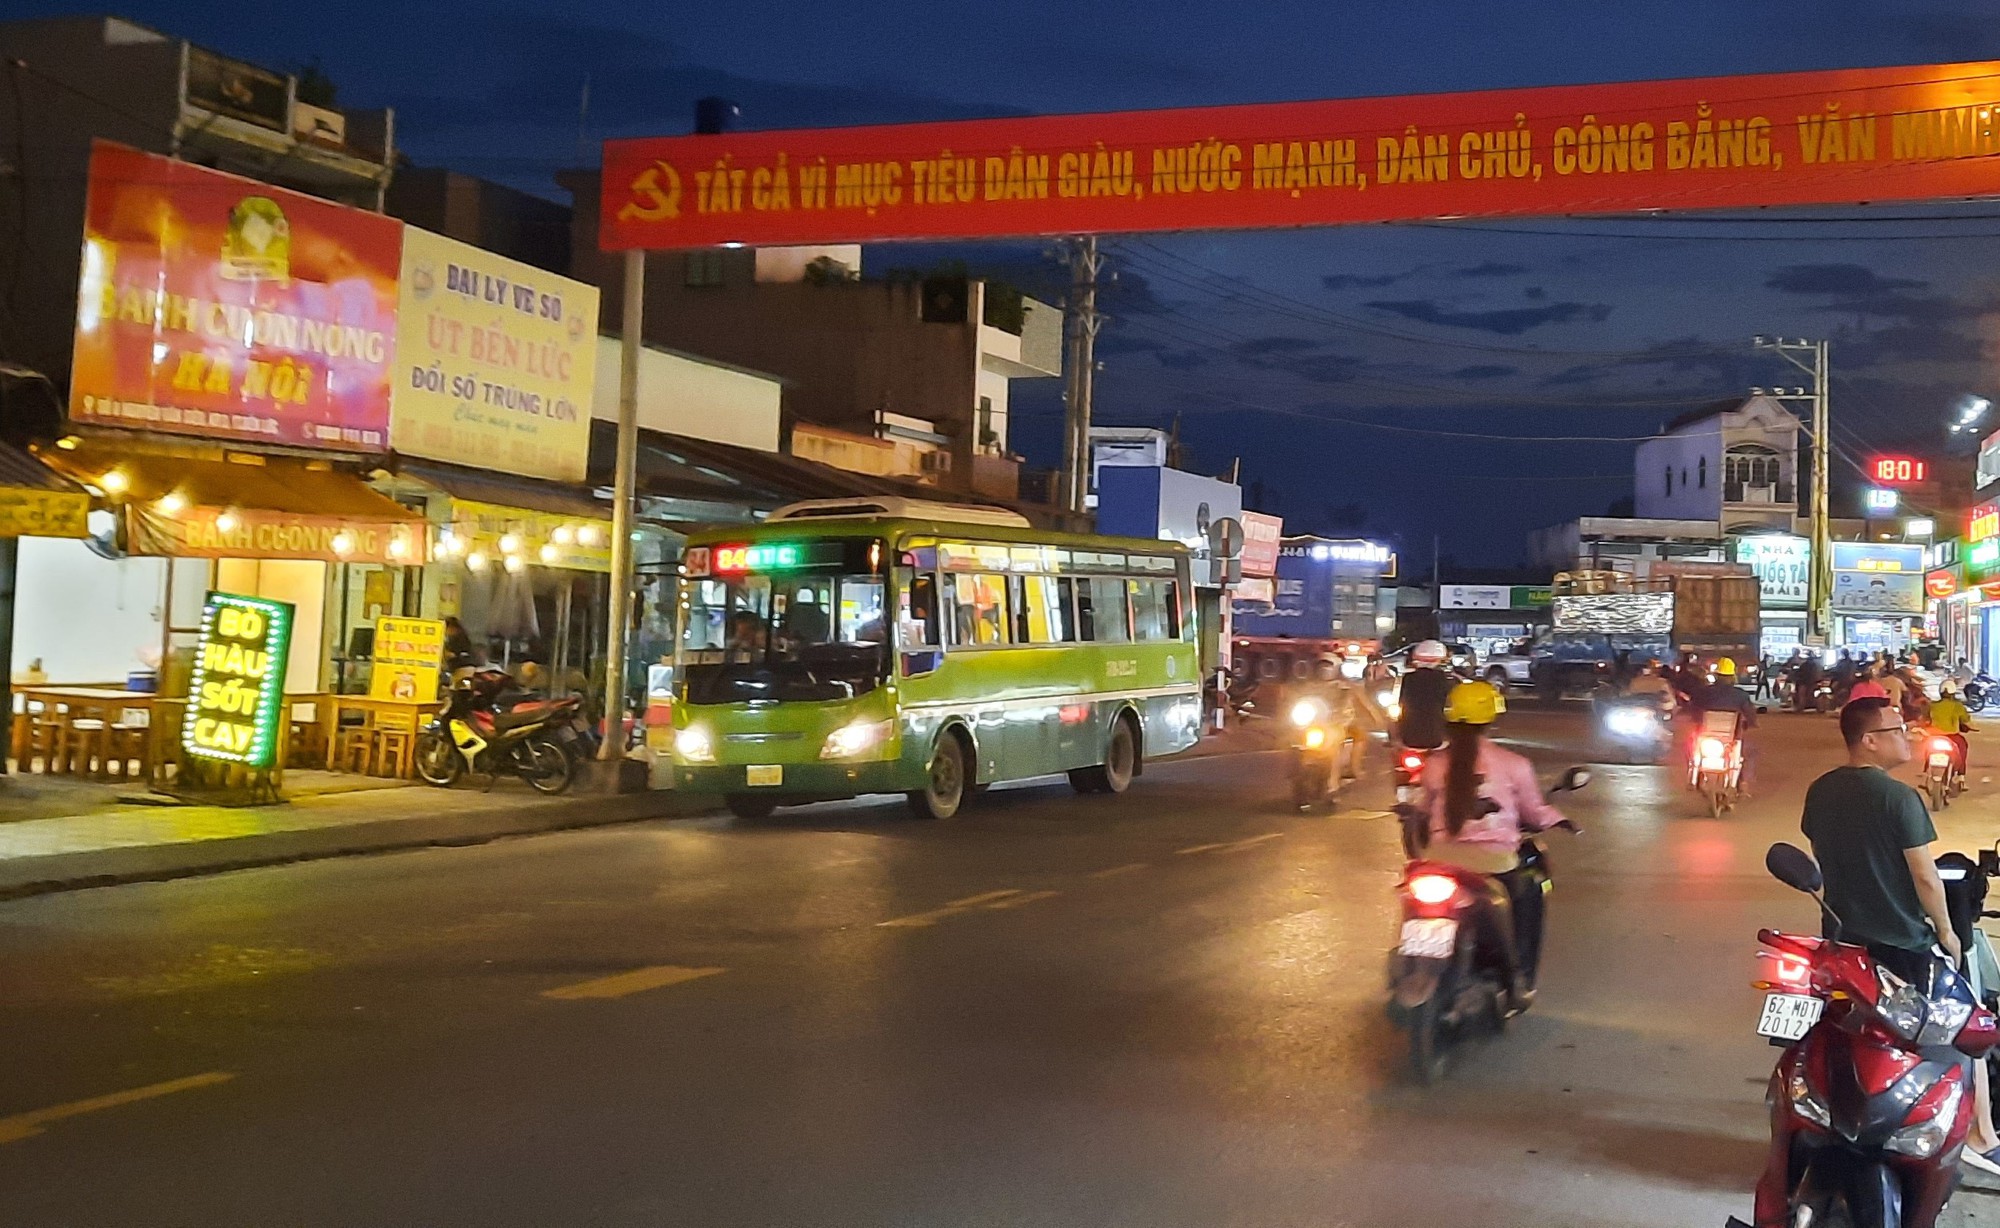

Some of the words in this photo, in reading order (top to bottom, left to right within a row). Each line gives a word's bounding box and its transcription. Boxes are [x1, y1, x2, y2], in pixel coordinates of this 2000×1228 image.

[695, 152, 746, 214] TẤT
[752, 151, 791, 211] CẢ
[800, 156, 827, 209] VÌ
[835, 161, 902, 216] MỤC
[911, 148, 975, 205] TIÊU
[984, 144, 1049, 201] DÂN
[1058, 141, 1143, 199] GIÀU,
[1152, 137, 1242, 193] NƯỚC
[1253, 139, 1367, 198] MẠNH,
[1377, 125, 1449, 185] DÂN
[1459, 112, 1543, 182] CHỦ,
[1553, 115, 1654, 175] CÔNG
[1667, 99, 1783, 173] BẰNG,
[1799, 102, 1876, 163] VĂN
[1892, 105, 1999, 160] MINH
[447, 263, 478, 300] ĐẠI
[470, 318, 520, 369] BẾN
[526, 337, 572, 382] LỨC
[411, 359, 446, 394] ĐỔI
[452, 372, 477, 401] SỐ
[482, 382, 541, 415] TRÚNG
[1790, 560, 1808, 584] TÂ
[218, 606, 262, 640] BÒ
[203, 642, 268, 678] HÀU
[194, 717, 255, 752] CAY
